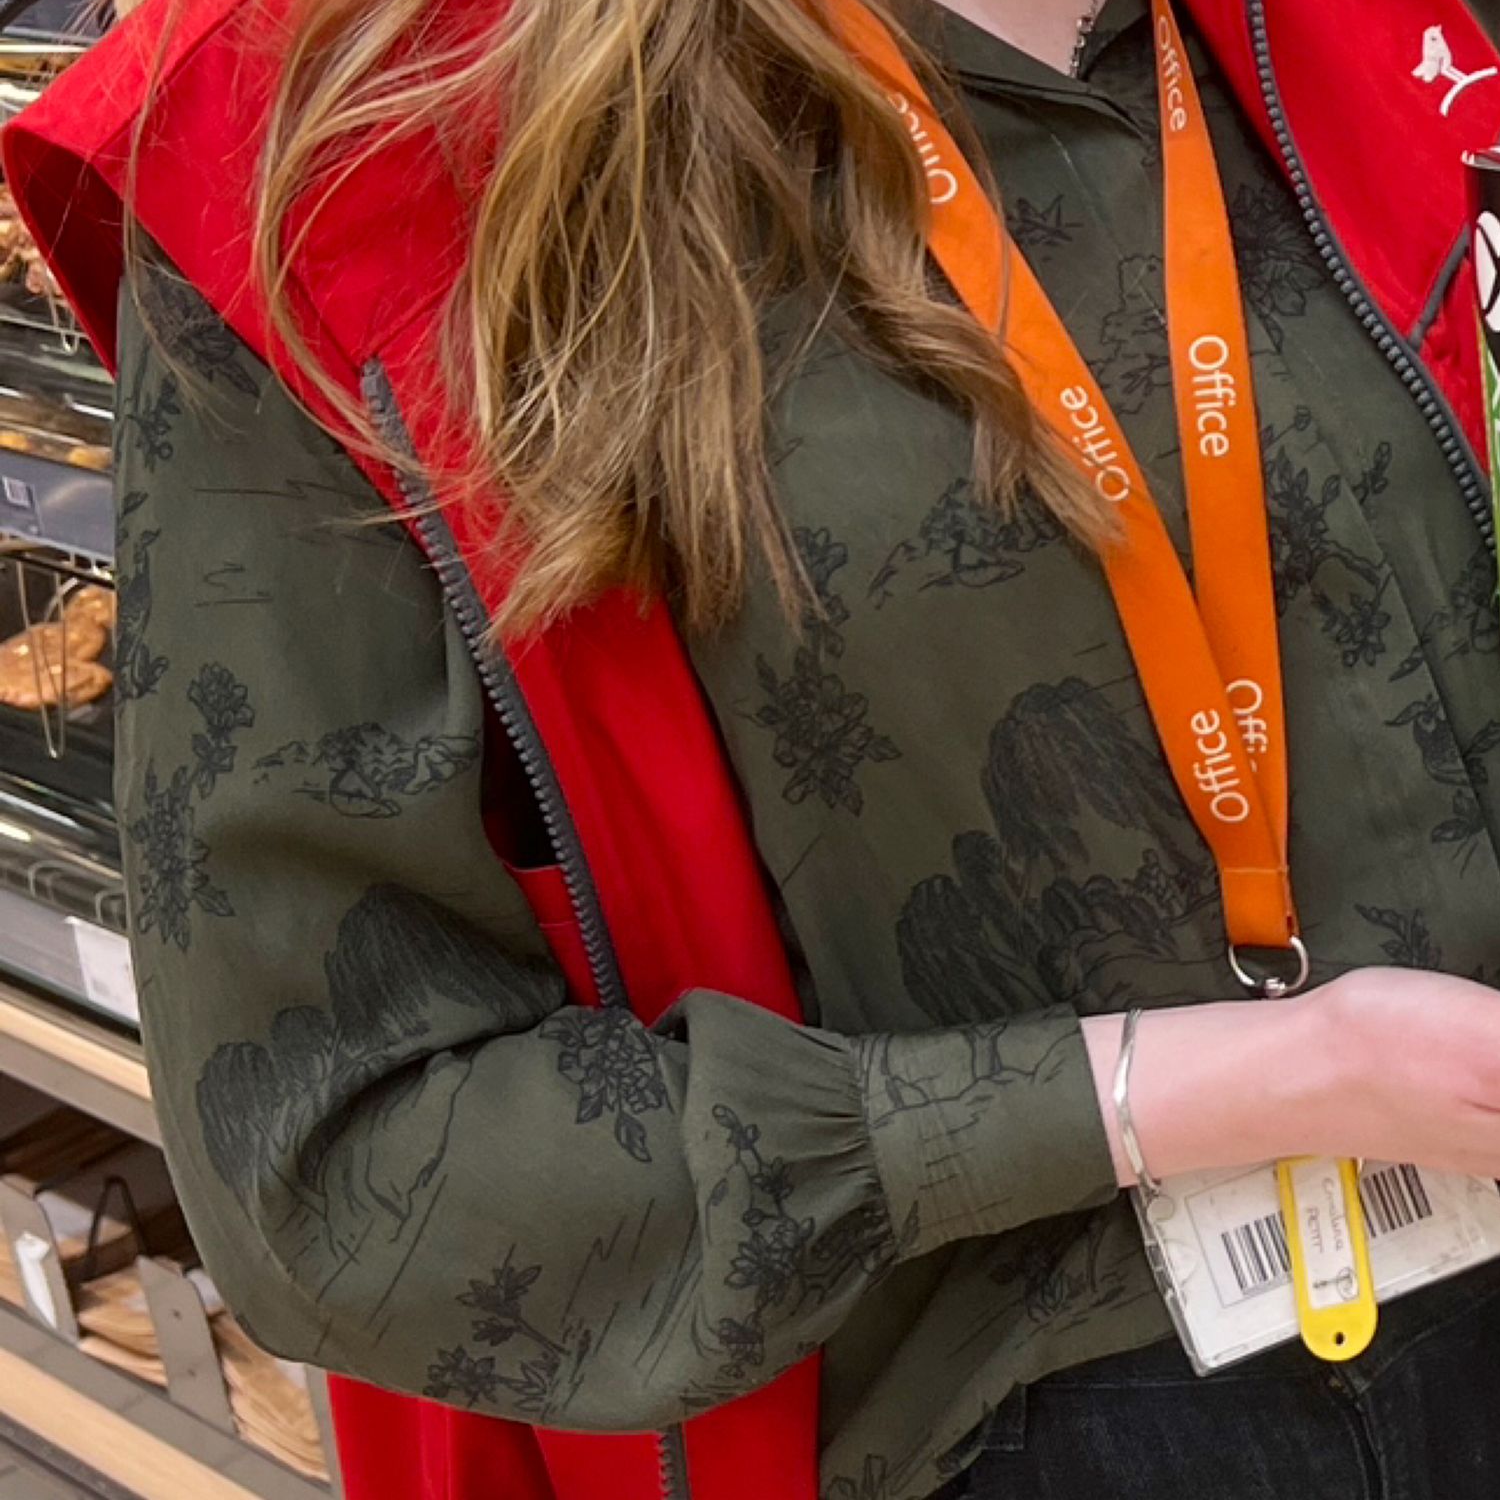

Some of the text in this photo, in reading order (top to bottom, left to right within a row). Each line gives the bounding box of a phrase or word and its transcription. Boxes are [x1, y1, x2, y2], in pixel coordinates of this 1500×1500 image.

[1158, 15, 1187, 132] Office
[1060, 385, 1131, 502] Office
[1189, 335, 1237, 458] Office
[1190, 708, 1250, 822] Office
[1225, 678, 1268, 773] Off
